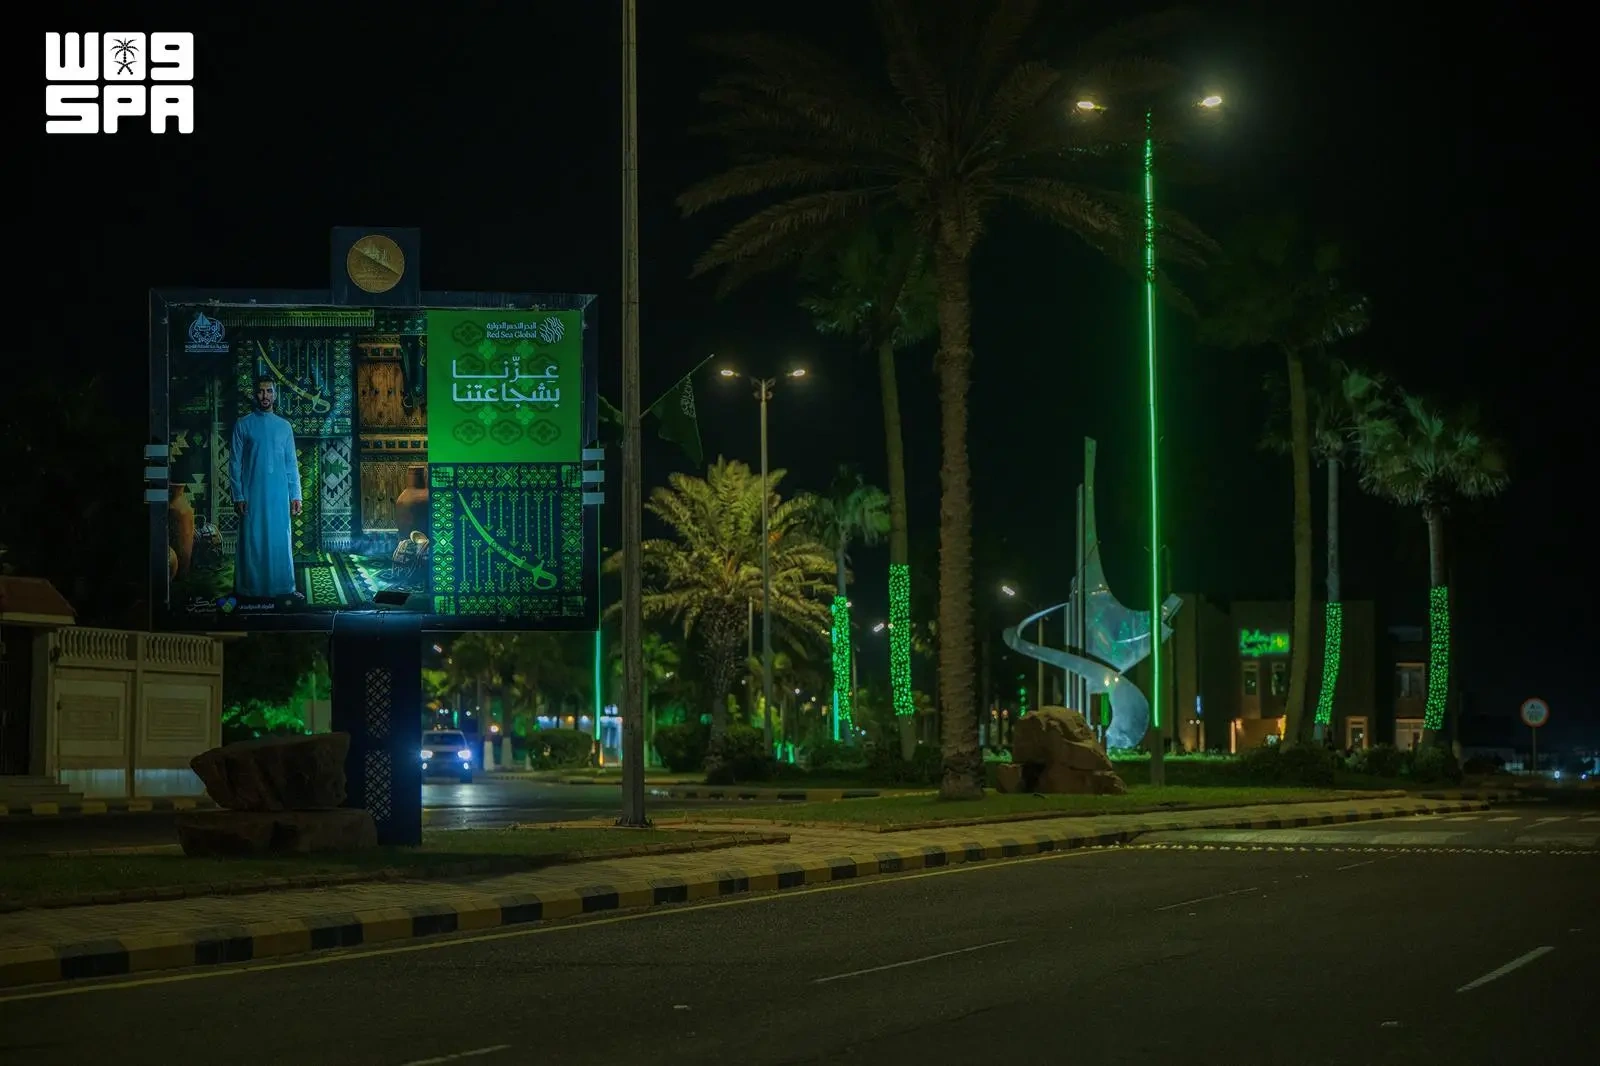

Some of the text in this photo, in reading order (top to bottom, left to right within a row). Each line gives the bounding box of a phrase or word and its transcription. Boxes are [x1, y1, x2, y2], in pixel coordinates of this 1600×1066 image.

[486, 331, 537, 339] Red Sea Global
[452, 383, 561, 408] بشجاعتنا
